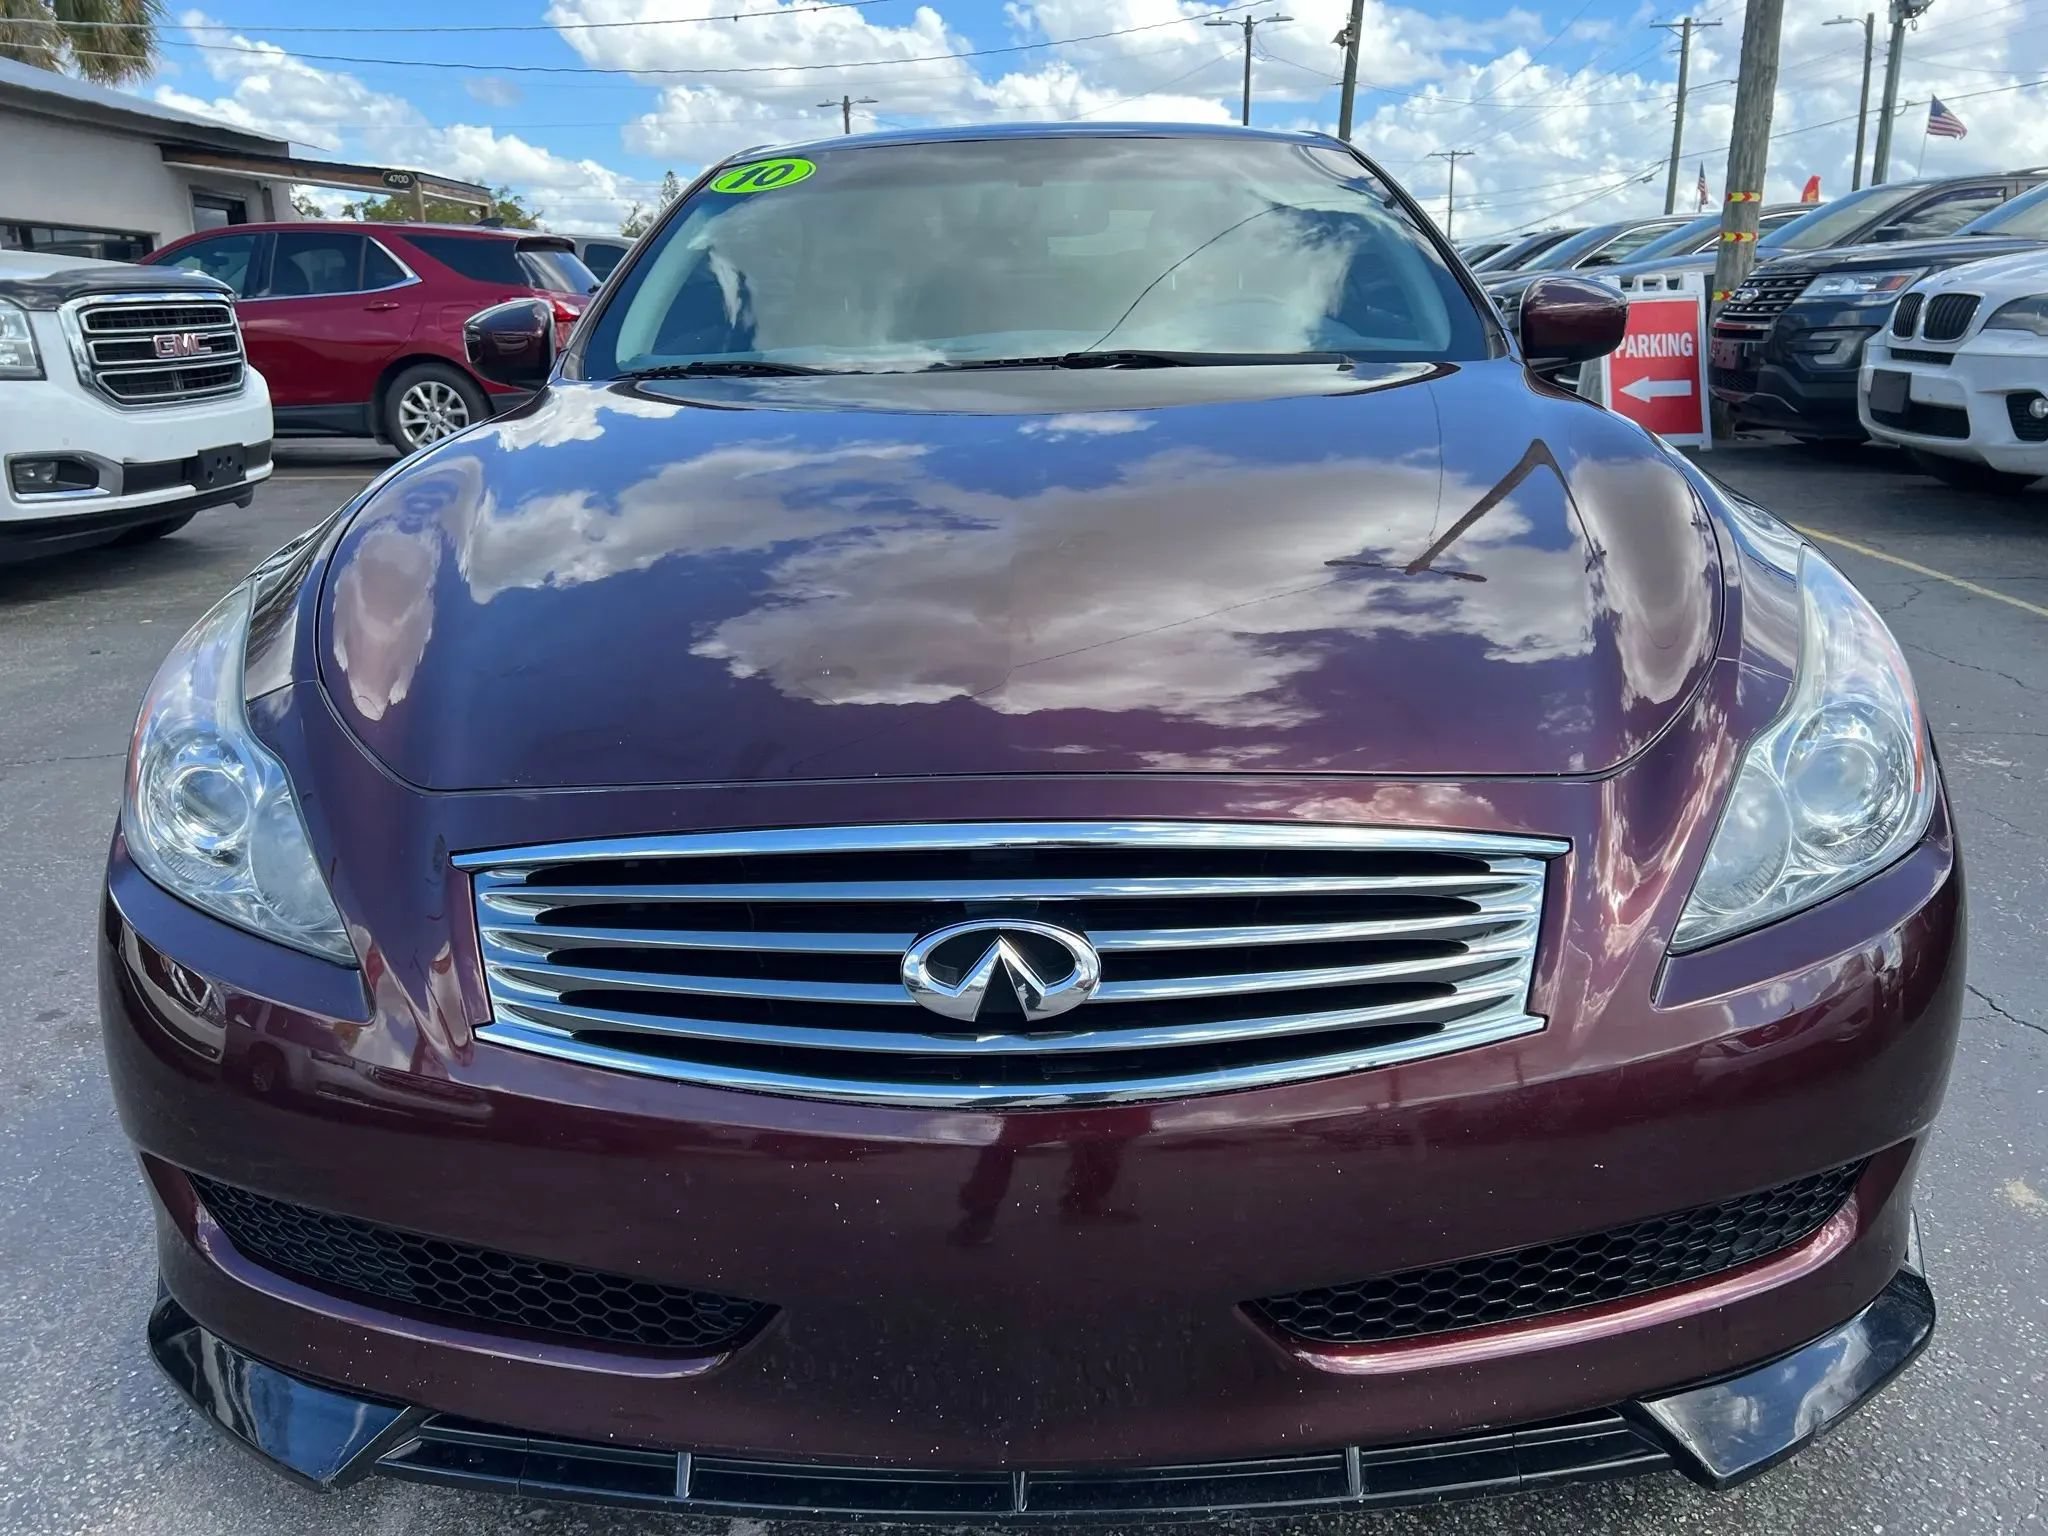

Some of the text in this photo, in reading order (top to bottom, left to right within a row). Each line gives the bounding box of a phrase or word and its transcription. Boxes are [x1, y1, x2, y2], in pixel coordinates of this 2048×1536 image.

[389, 175, 409, 183] 4700
[726, 164, 796, 190] 10
[153, 333, 213, 358] GMC
